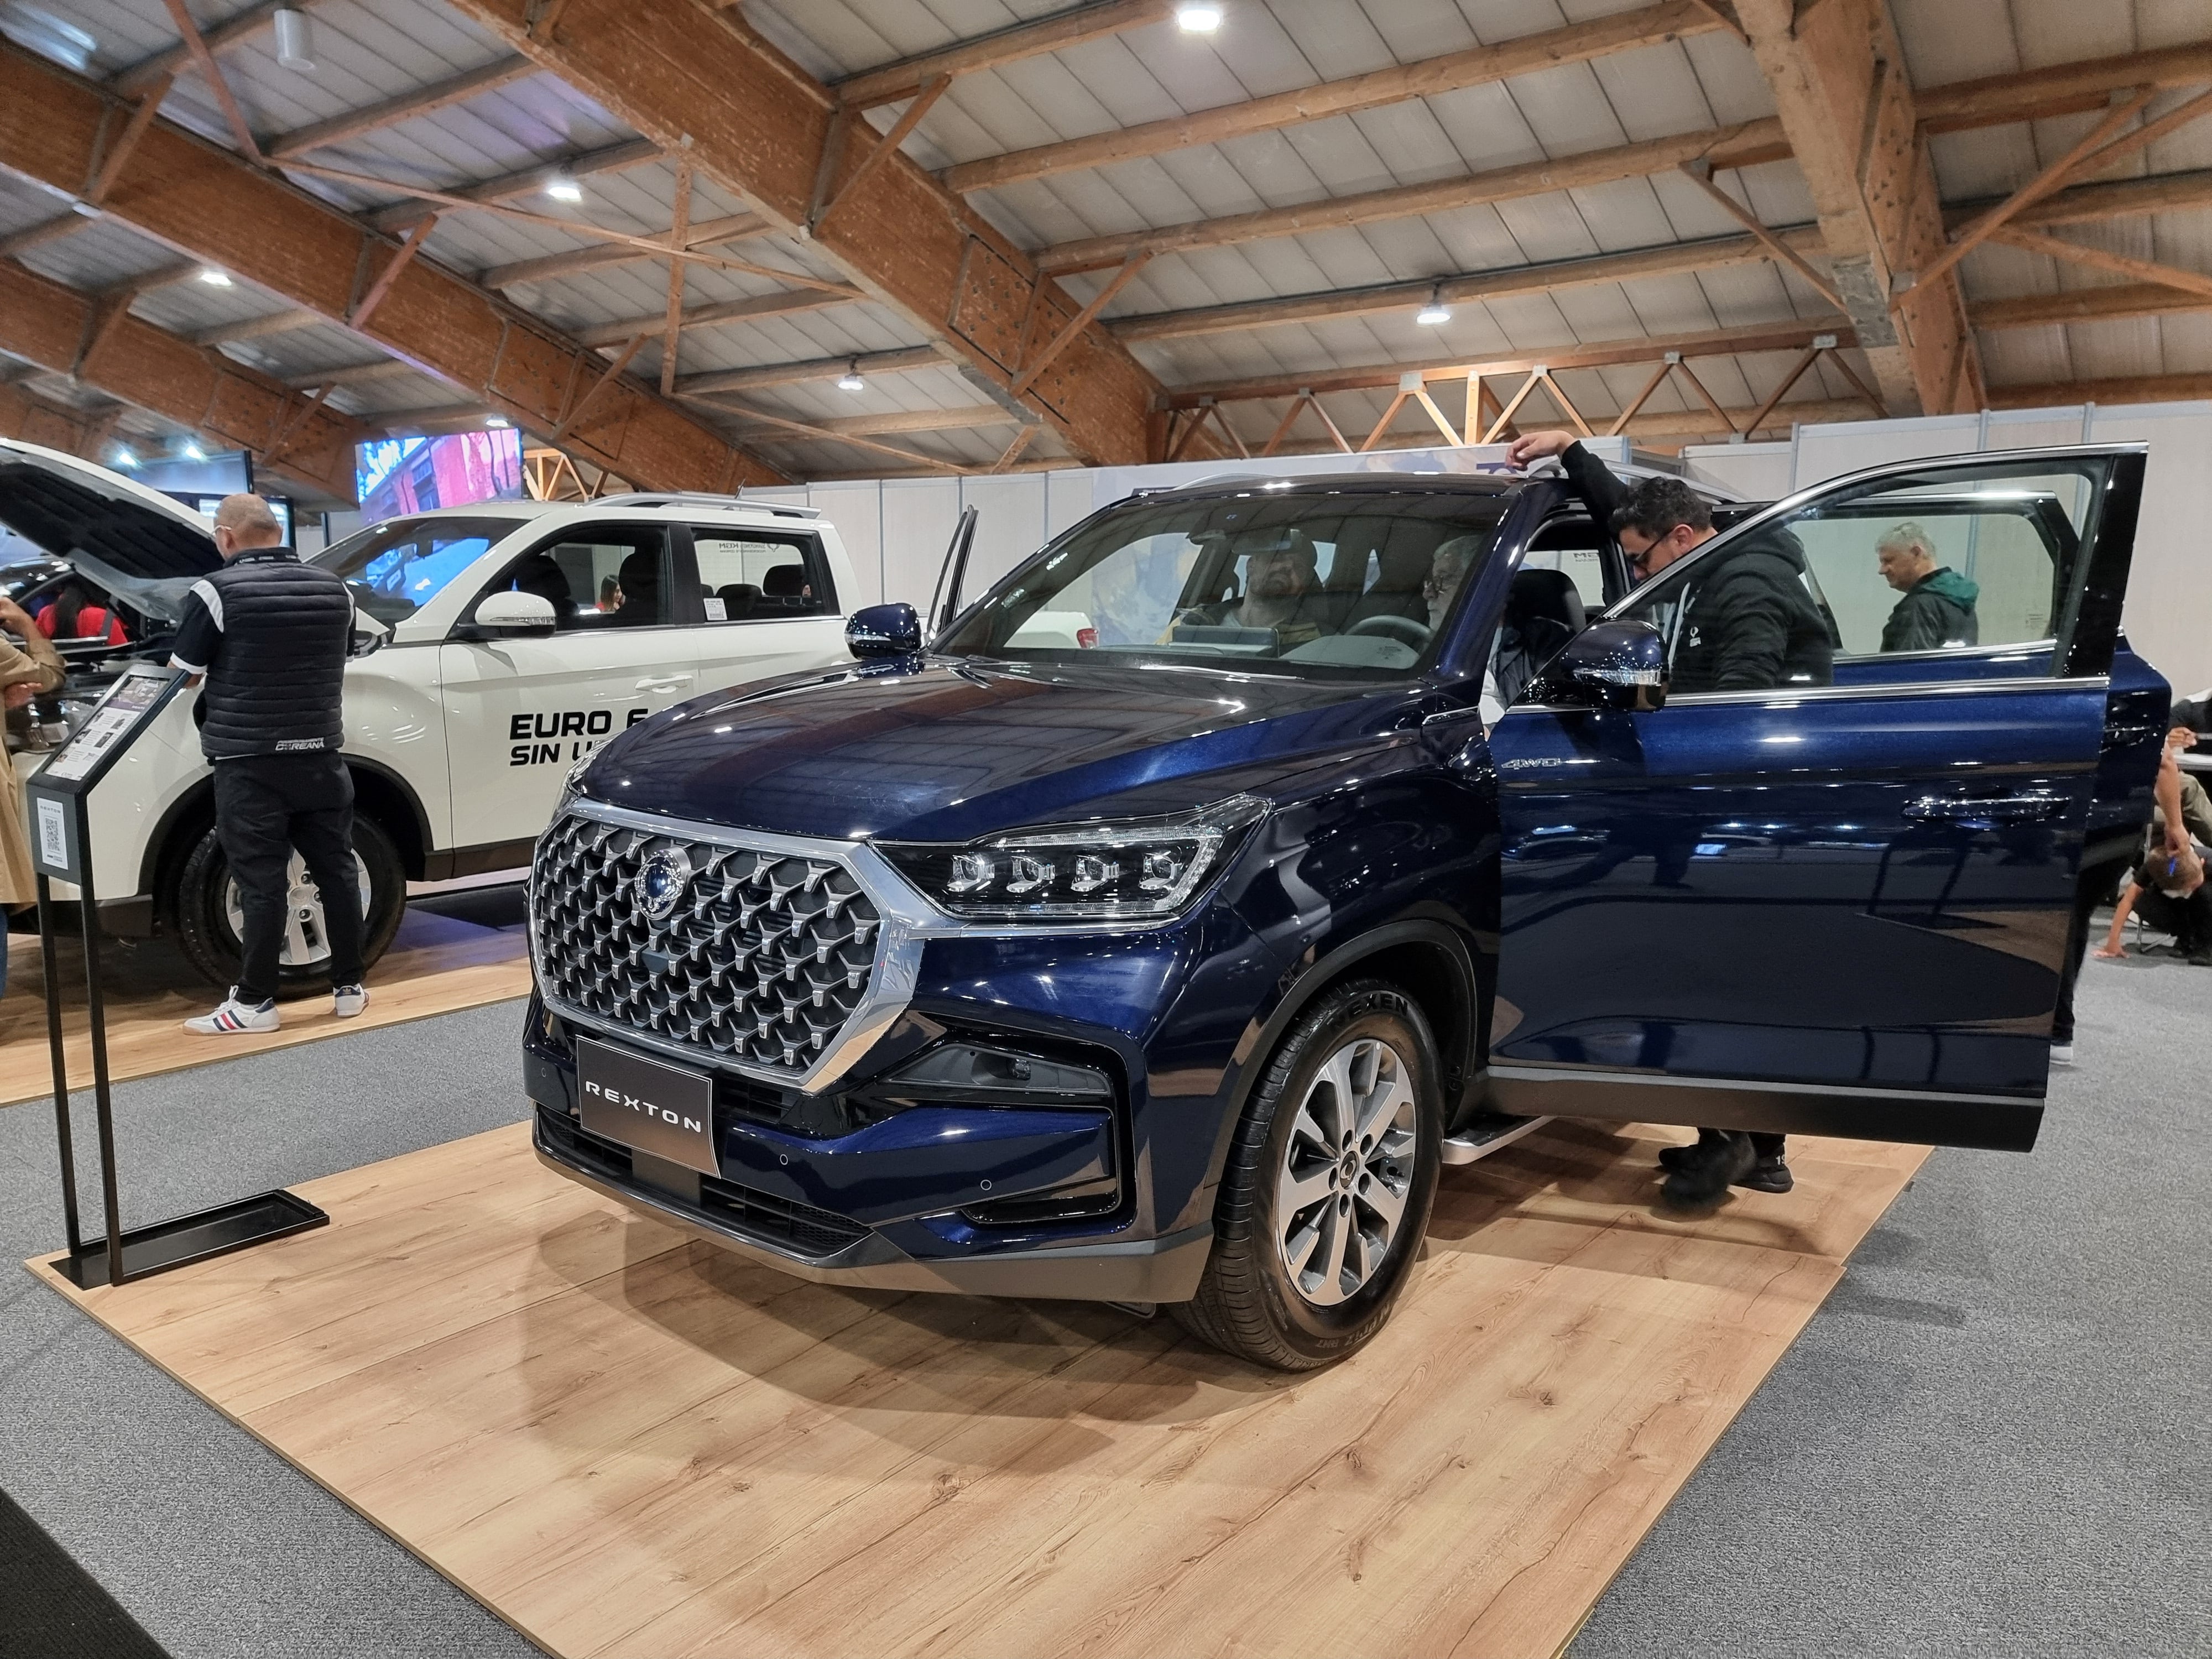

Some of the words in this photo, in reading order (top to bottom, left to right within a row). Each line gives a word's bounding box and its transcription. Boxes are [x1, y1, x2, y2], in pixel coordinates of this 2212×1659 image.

[510, 710, 612, 740] EURO
[510, 743, 560, 766] SIN
[1501, 758, 1561, 770] 4WD
[586, 1081, 701, 1133] REXTON
